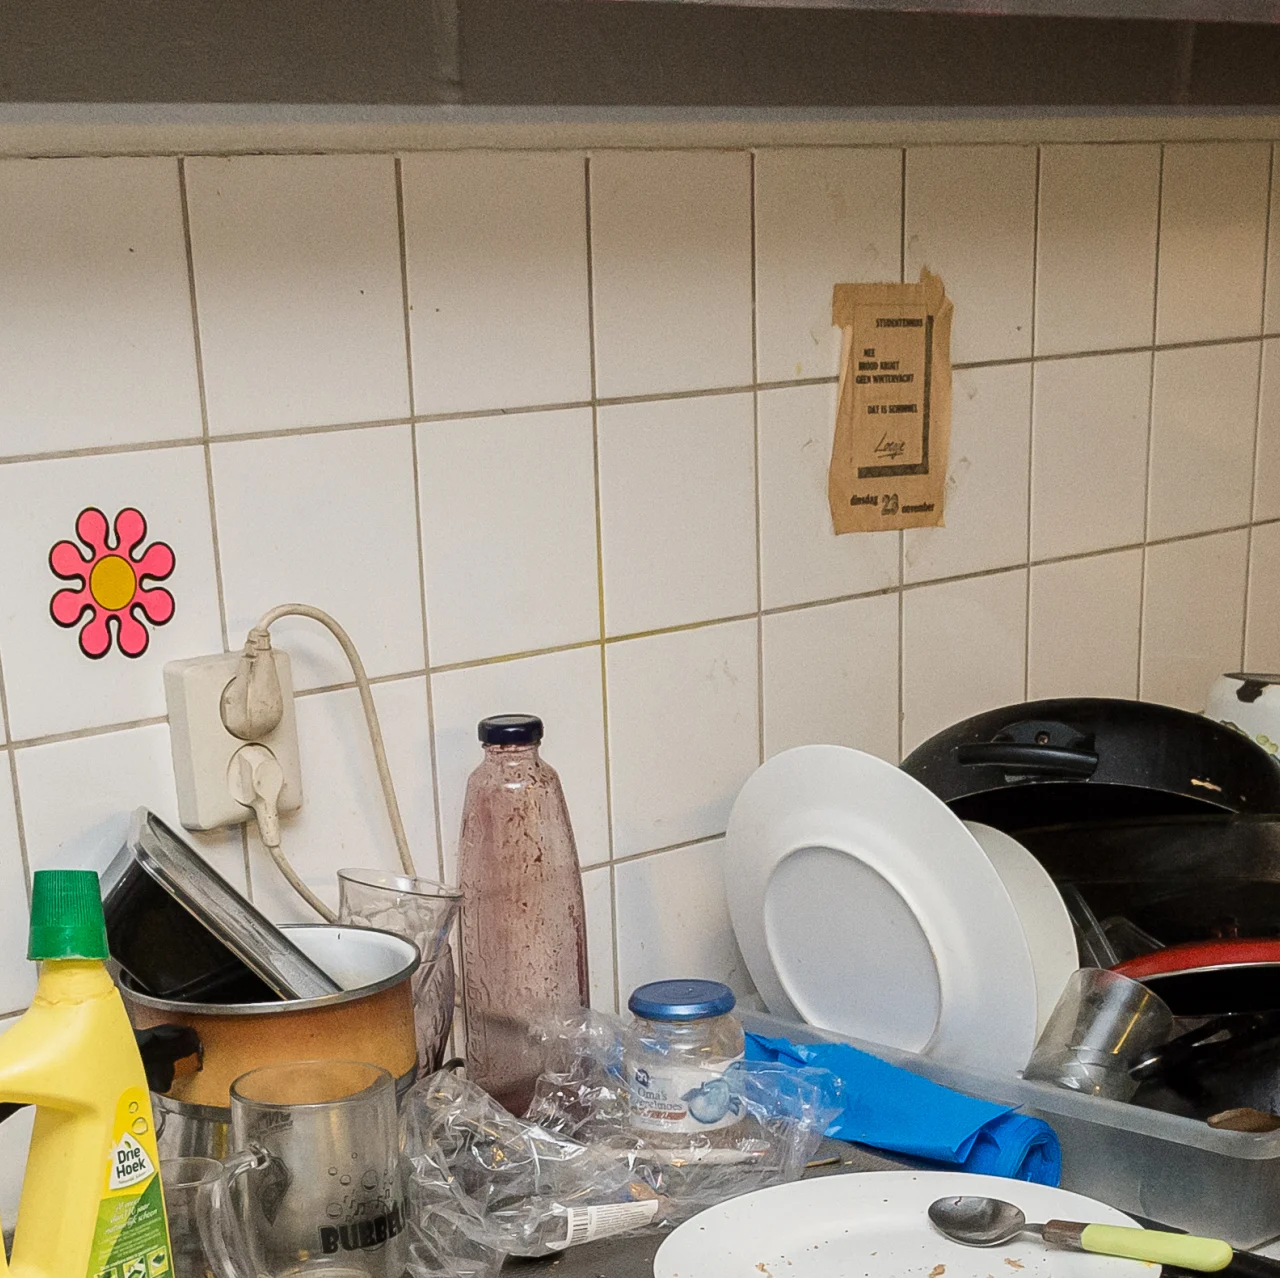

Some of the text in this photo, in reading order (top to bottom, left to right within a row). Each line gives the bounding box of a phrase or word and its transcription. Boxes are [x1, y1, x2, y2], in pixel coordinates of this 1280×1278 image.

[855, 375, 872, 385] GEEN
[867, 404, 880, 415] DAT
[881, 404, 888, 414] IS
[901, 501, 935, 514] november
[117, 1146, 142, 1165] Drie
[116, 1157, 147, 1179] Hoek
